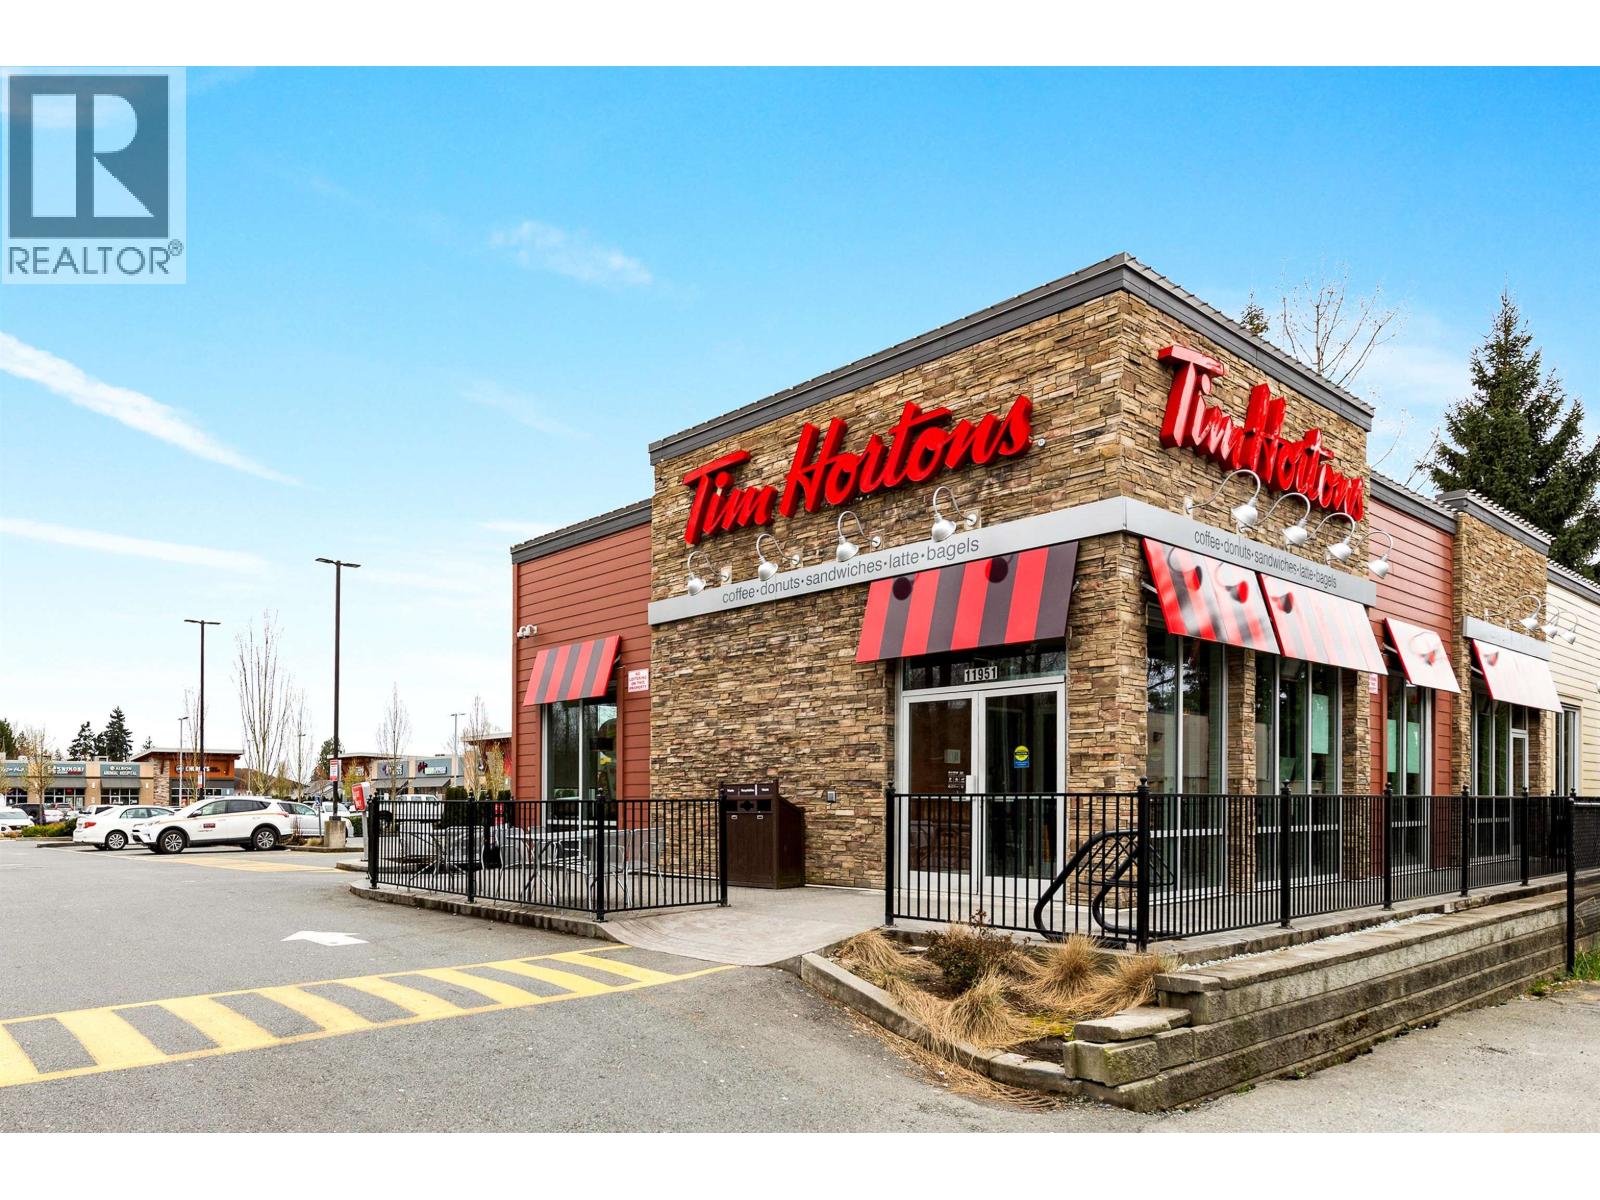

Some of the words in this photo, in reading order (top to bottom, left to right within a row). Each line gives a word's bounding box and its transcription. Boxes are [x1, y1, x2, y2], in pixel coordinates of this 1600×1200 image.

[682, 449, 778, 546] Tim
[779, 394, 1034, 519] Hortons
[1158, 344, 1245, 471] Tim
[1240, 383, 1364, 521] Hortons
[965, 666, 996, 682] 11951
